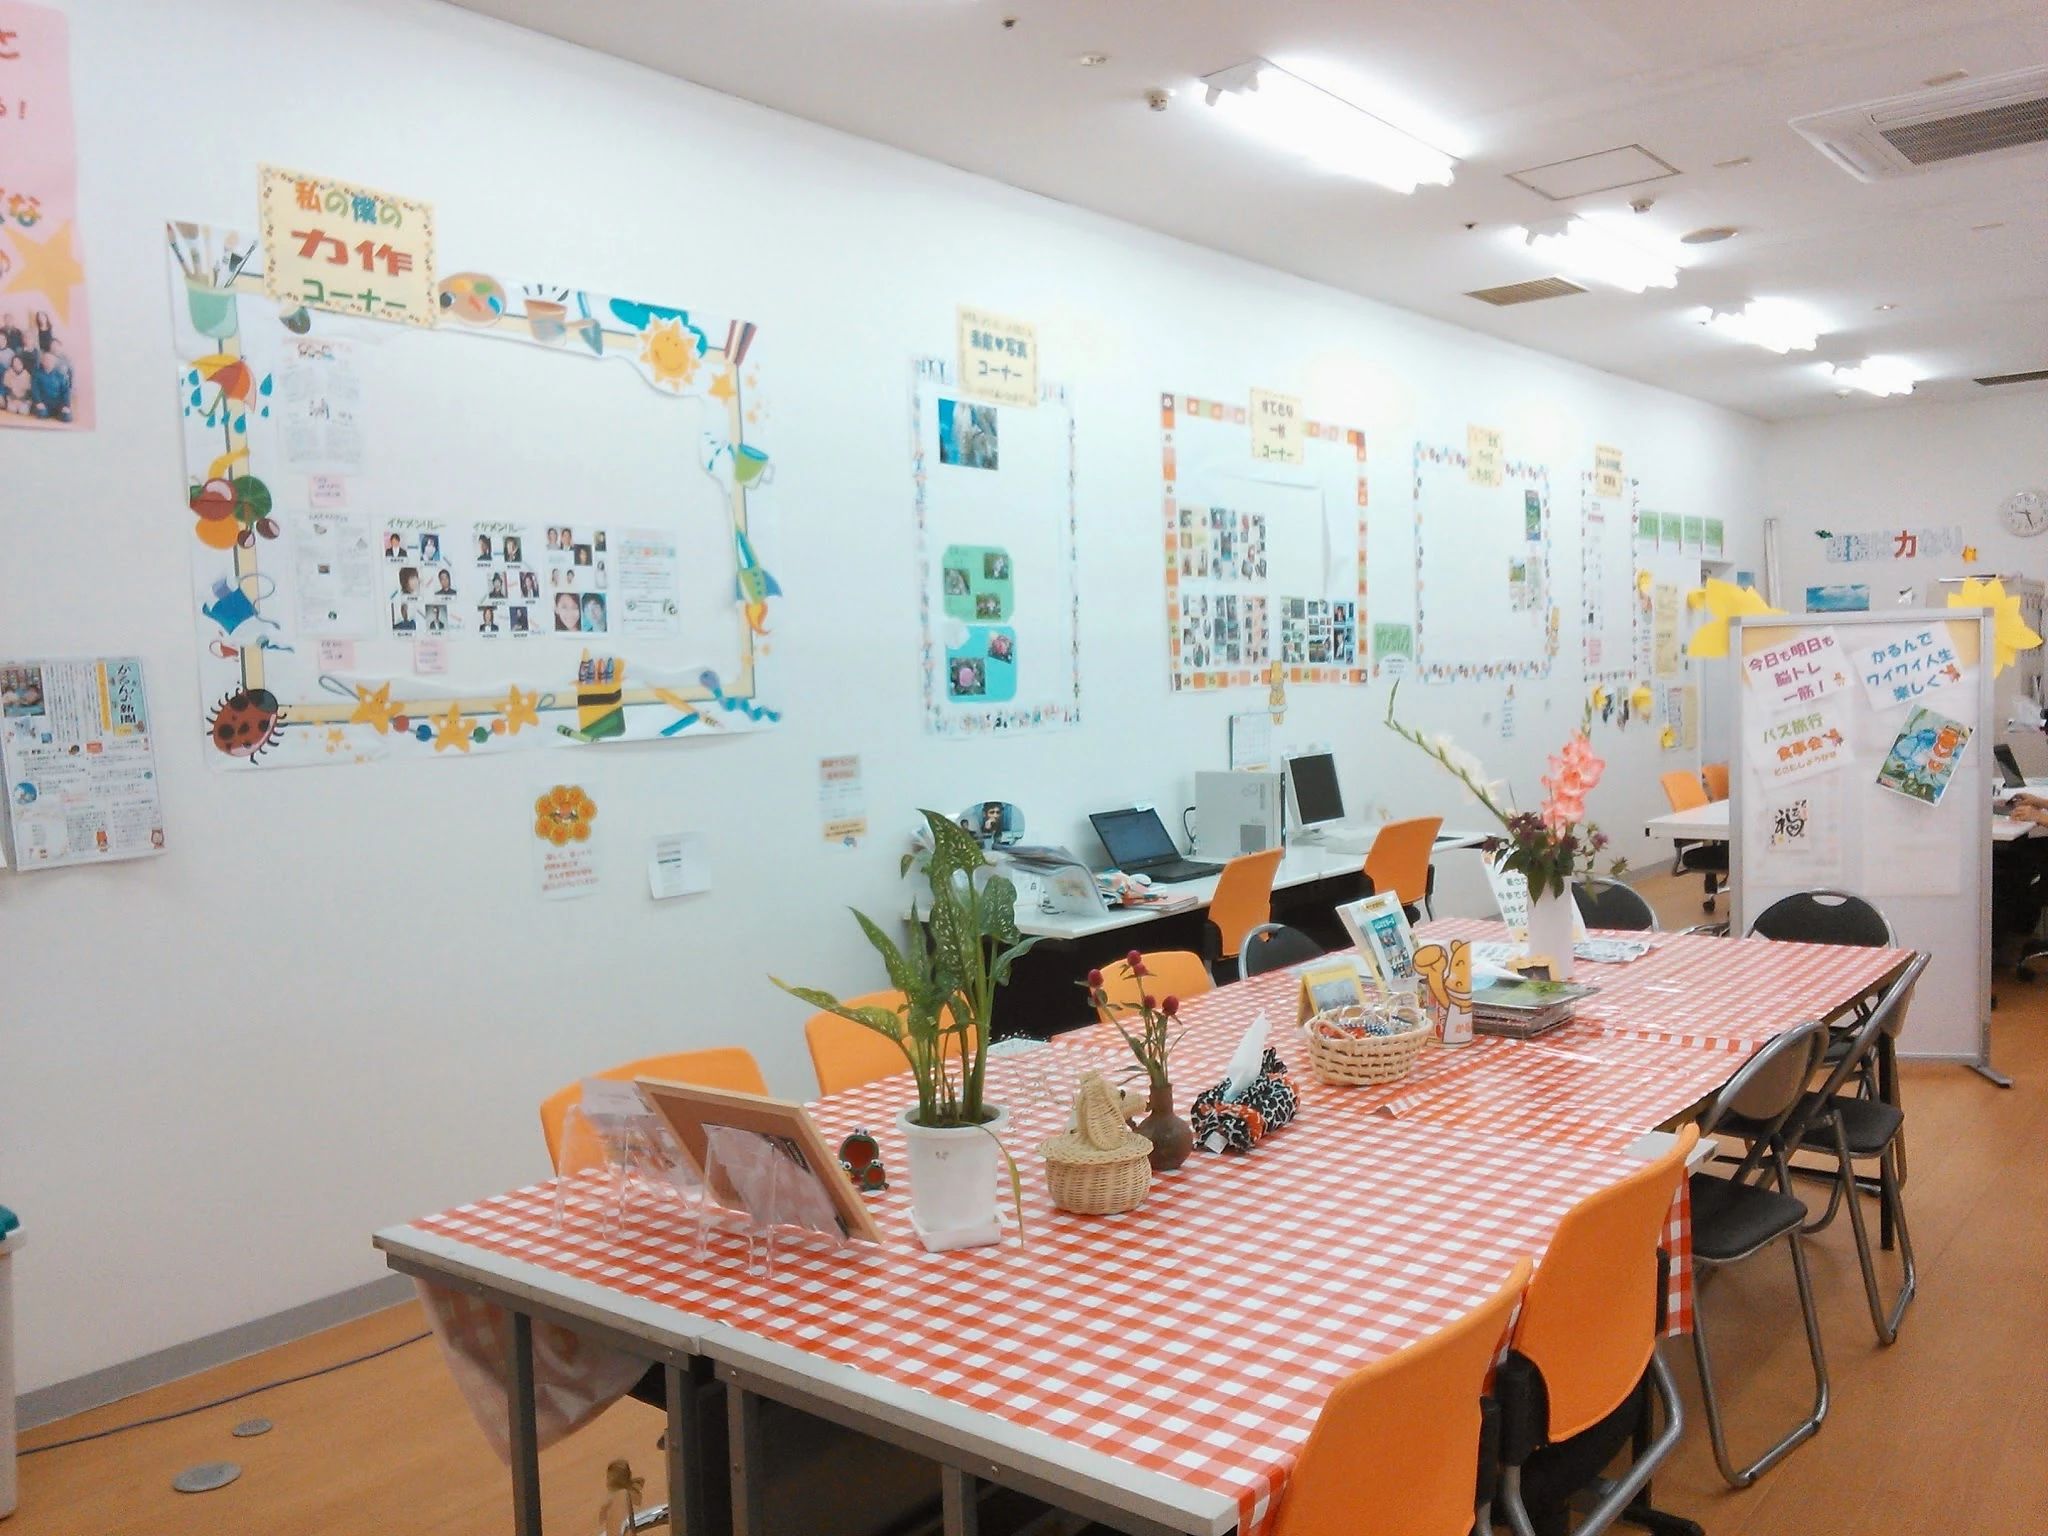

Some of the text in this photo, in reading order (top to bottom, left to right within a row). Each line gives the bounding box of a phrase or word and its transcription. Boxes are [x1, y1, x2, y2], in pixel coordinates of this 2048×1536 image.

[295, 180, 402, 229] 私の僕の
[291, 229, 413, 276] 力作
[303, 279, 406, 312] コーナー
[978, 360, 1022, 381] コーナー
[1749, 635, 1834, 672] 今日も明日も
[1866, 649, 1954, 686] ワイワイ人生
[1774, 662, 1821, 687] 脳トレ
[1893, 675, 1941, 702] 楽しく
